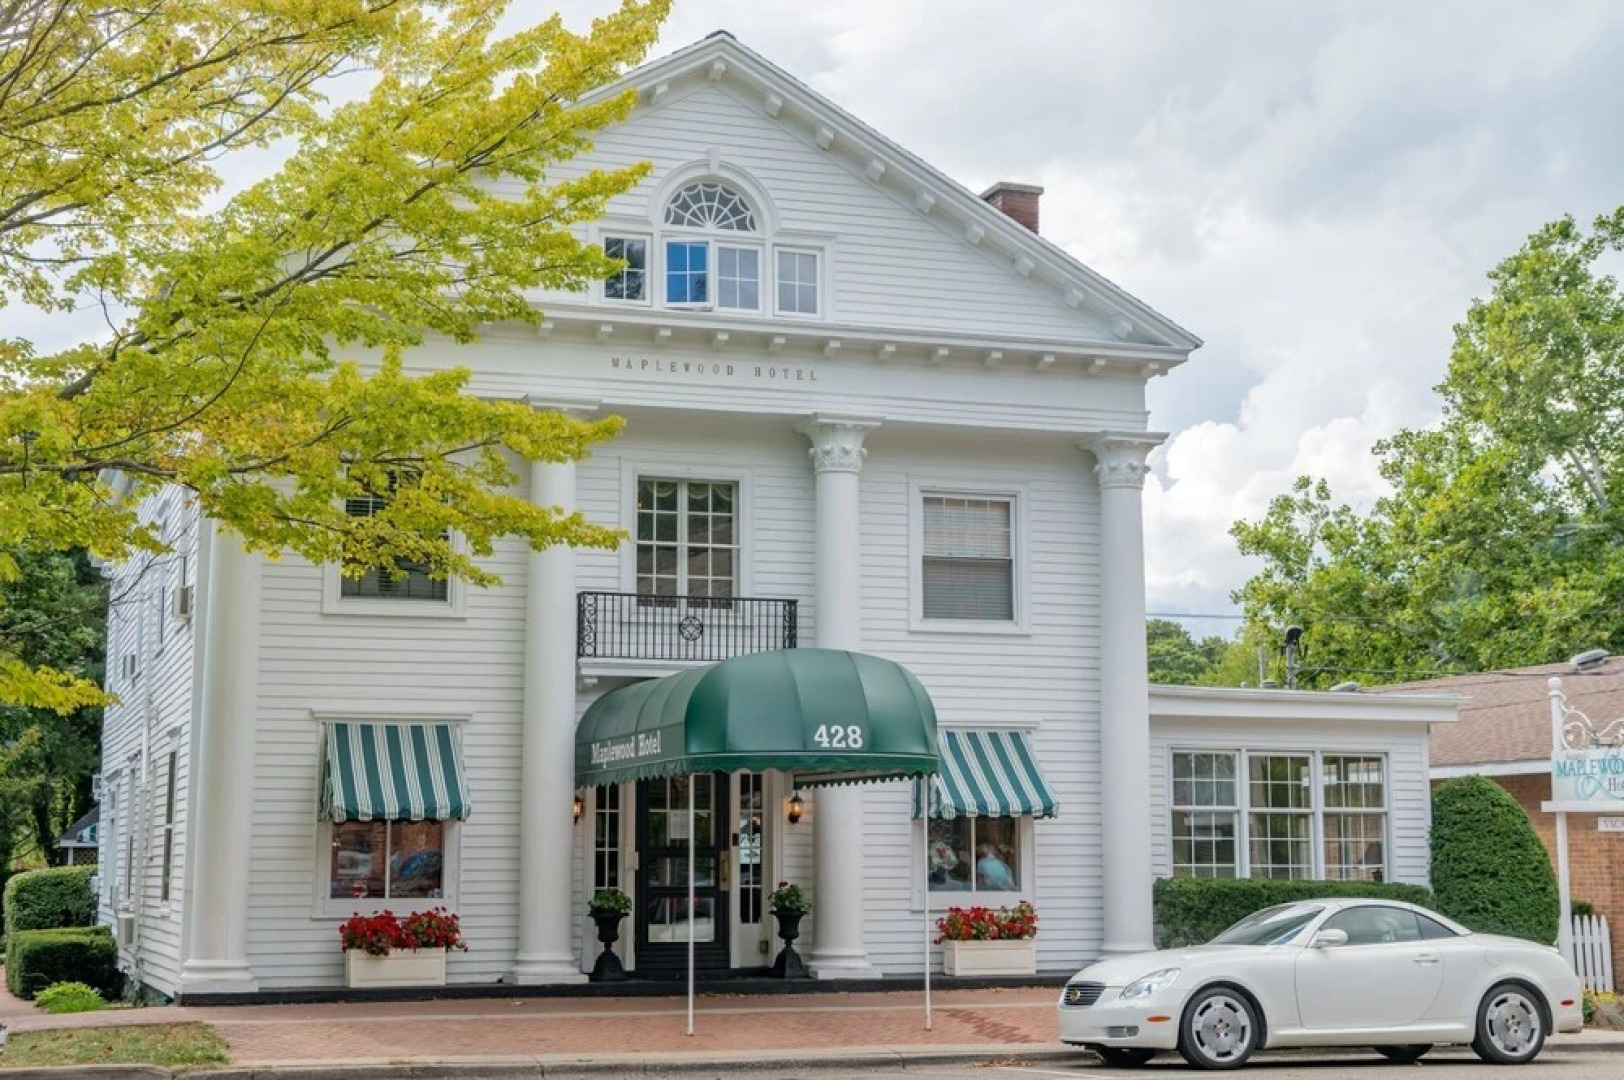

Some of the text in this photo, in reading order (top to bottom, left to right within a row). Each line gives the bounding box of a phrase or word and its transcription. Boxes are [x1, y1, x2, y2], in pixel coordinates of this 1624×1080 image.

[611, 357, 818, 381] MAPLEWOOD HOTEL
[813, 725, 863, 748] 428
[591, 730, 661, 769] Maplewood Hotel
